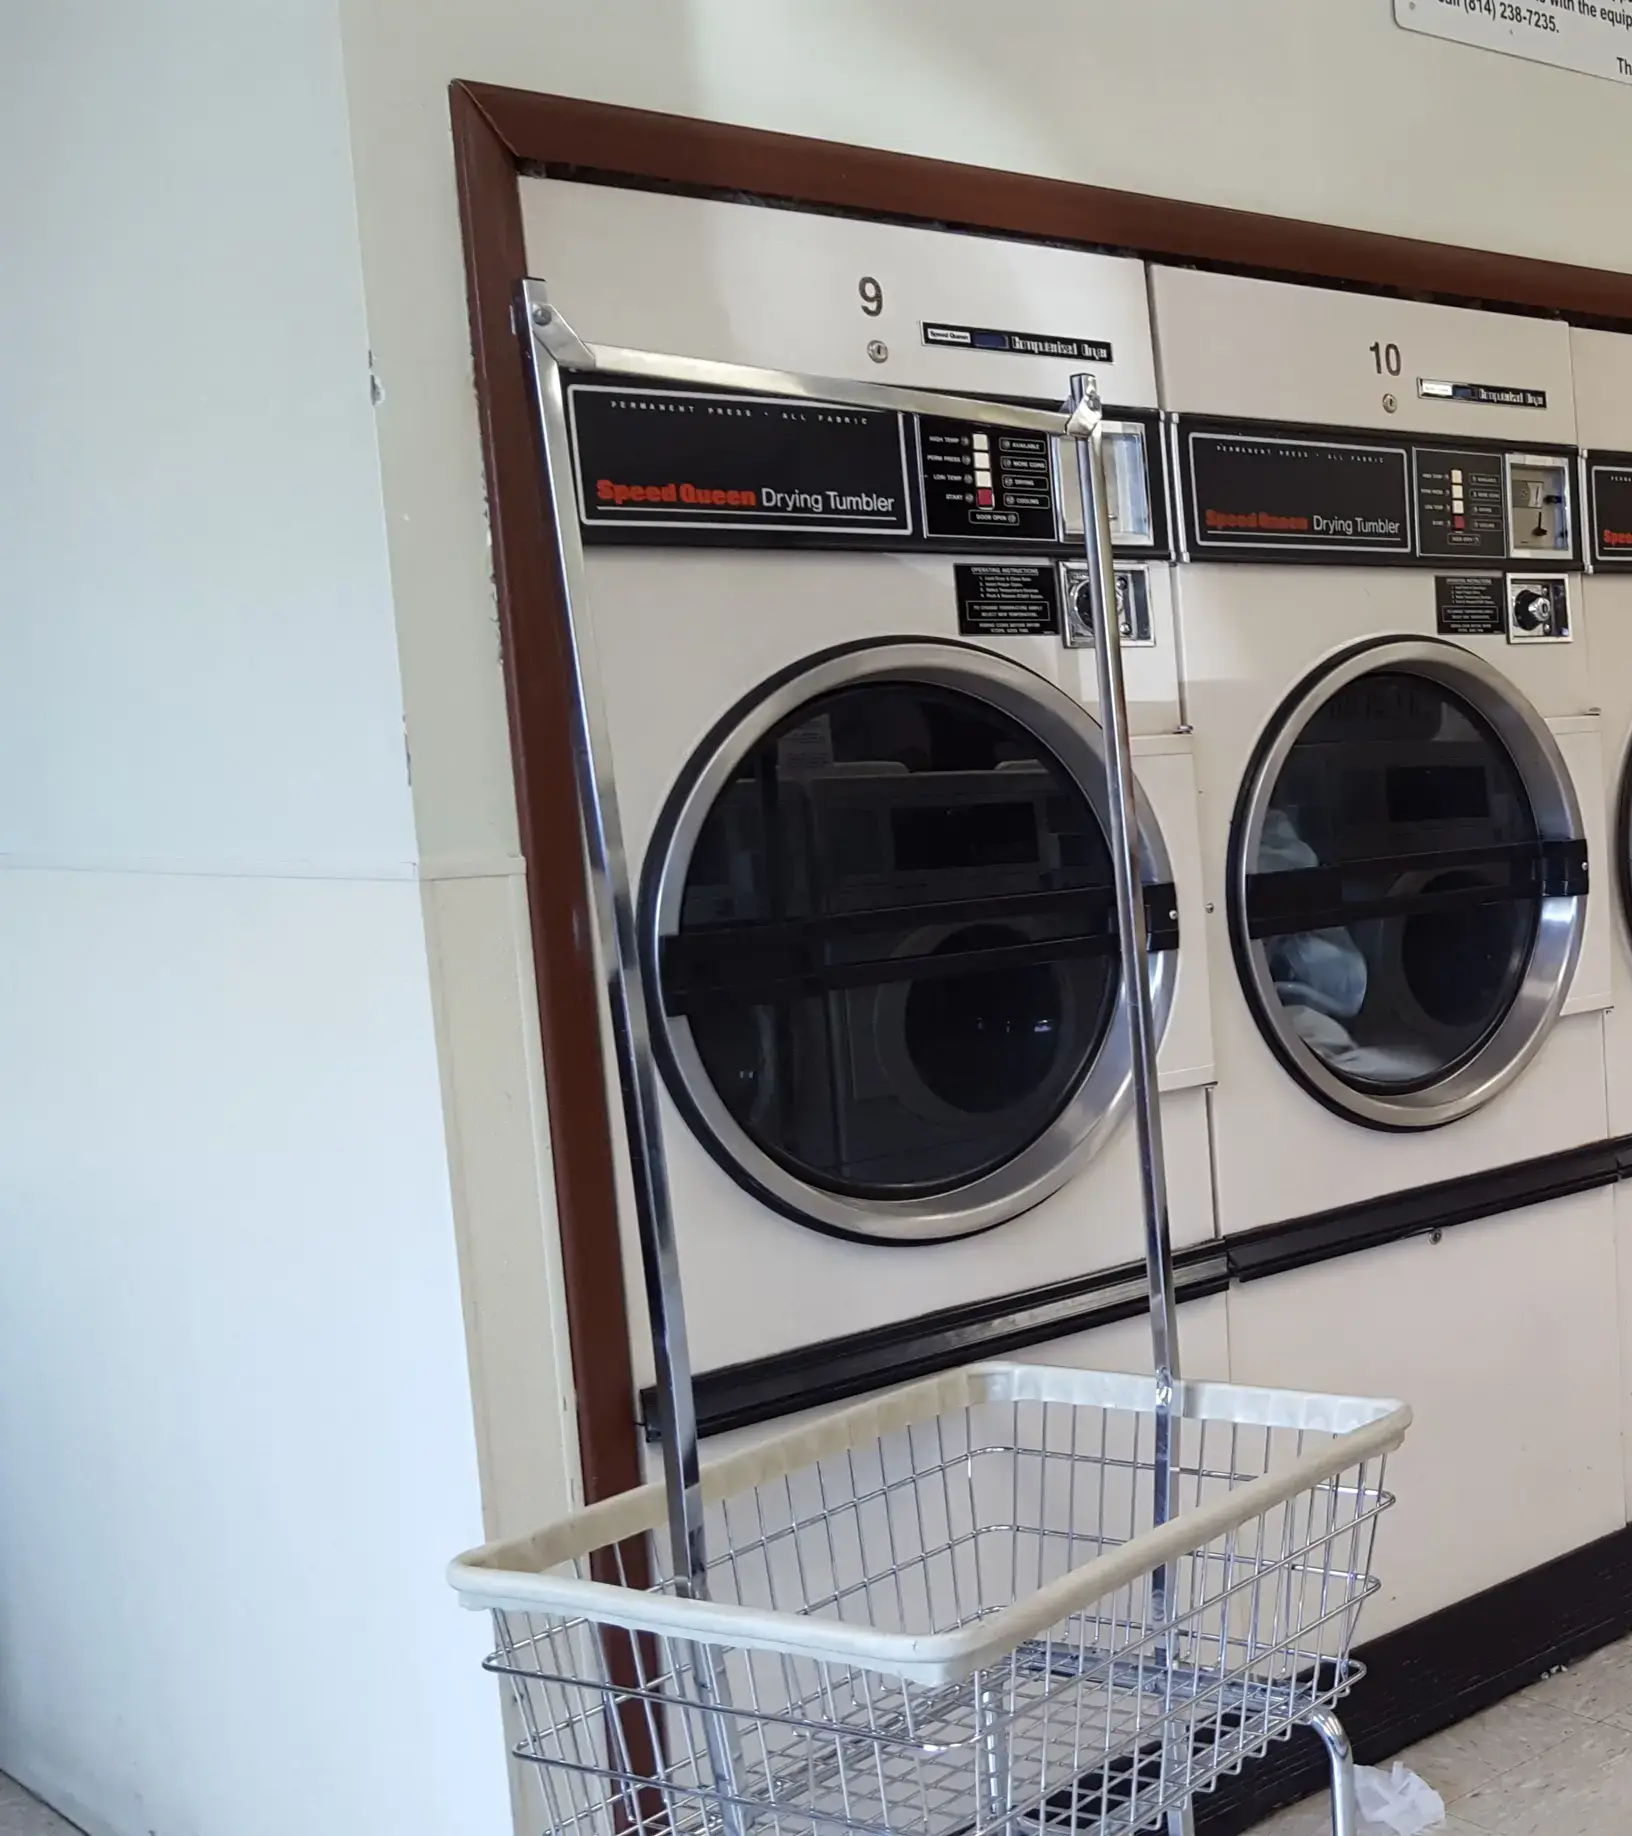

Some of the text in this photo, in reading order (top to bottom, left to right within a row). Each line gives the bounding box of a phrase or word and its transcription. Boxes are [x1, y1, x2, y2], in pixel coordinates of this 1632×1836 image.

[1464, 0, 1560, 33] (814) 238-7235.
[1551, 0, 1575, 14] with
[1578, 1, 1597, 18] the
[859, 276, 883, 317] 9
[1369, 341, 1401, 377] 10
[610, 400, 868, 426] PERMANENT PRESS ALL FABRIC
[596, 479, 895, 512] Speed Queen Drying Tumbler
[1205, 509, 1257, 530] Speed
[1313, 515, 1353, 535] Drying
[1355, 517, 1400, 534] Tumbler
